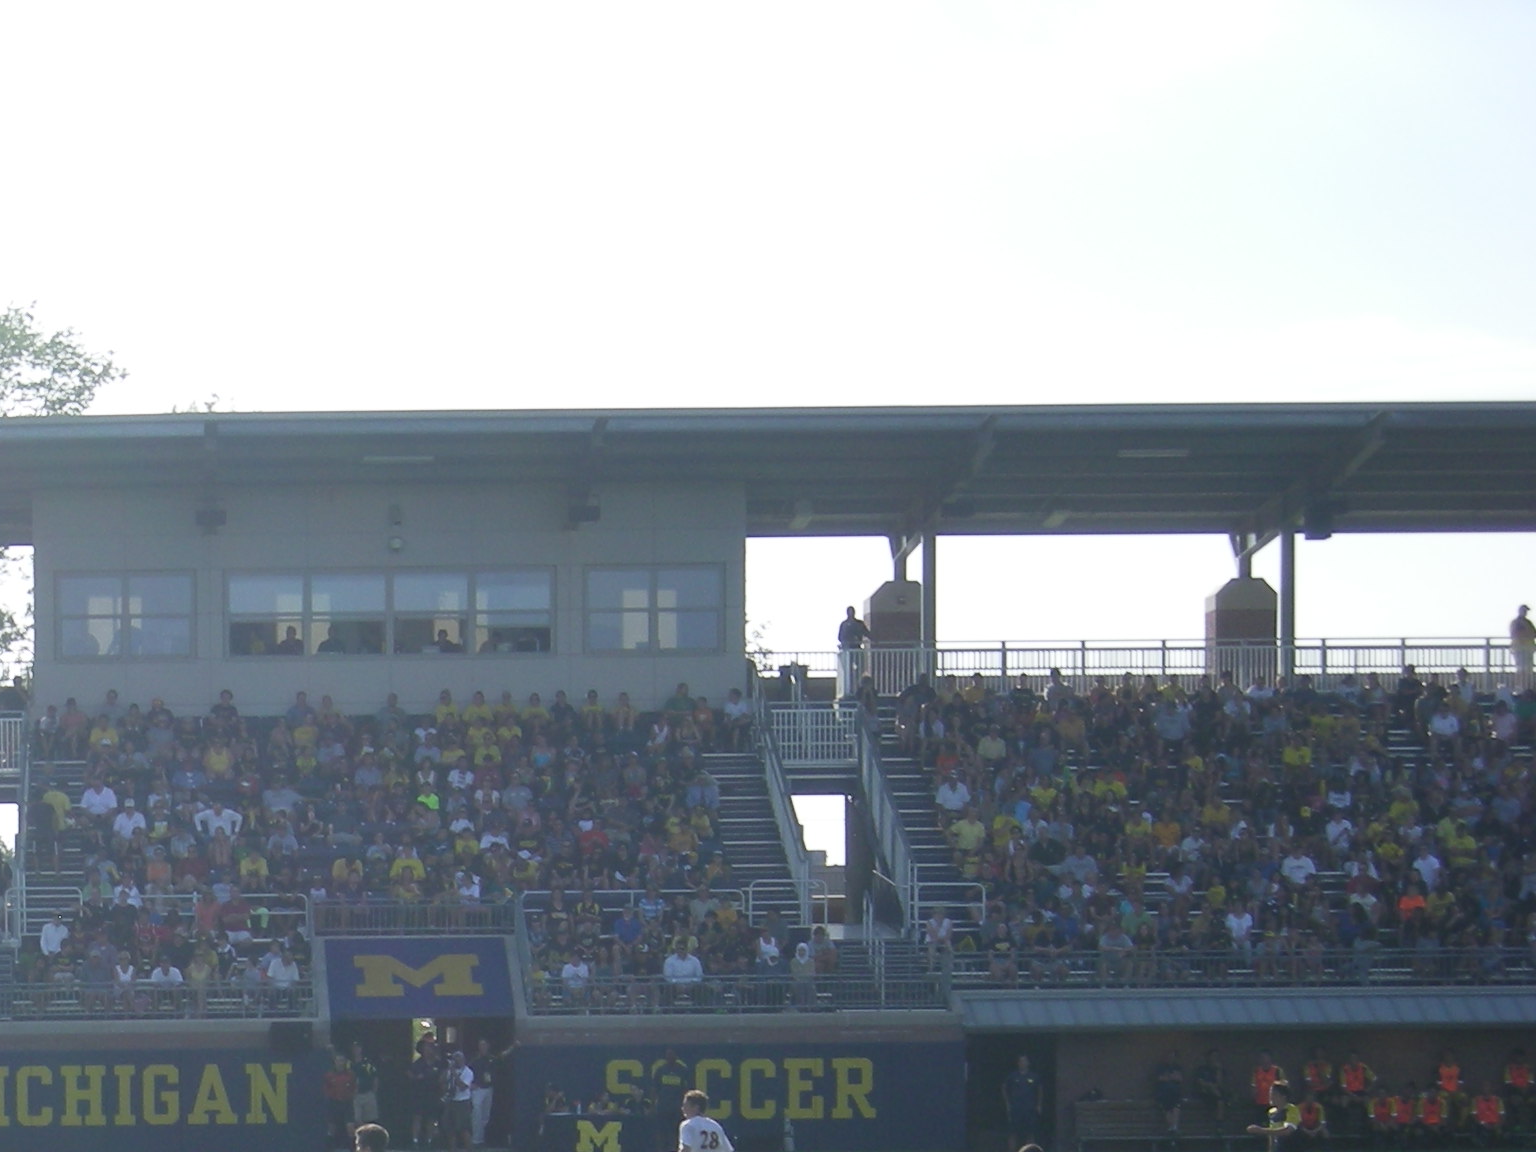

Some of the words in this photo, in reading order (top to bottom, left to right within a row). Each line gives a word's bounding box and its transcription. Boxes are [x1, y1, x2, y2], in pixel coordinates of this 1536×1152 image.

[354, 954, 483, 996] M
[605, 1057, 877, 1120] SCCER
[576, 1121, 622, 1152] M
[700, 1131, 719, 1149] 28
